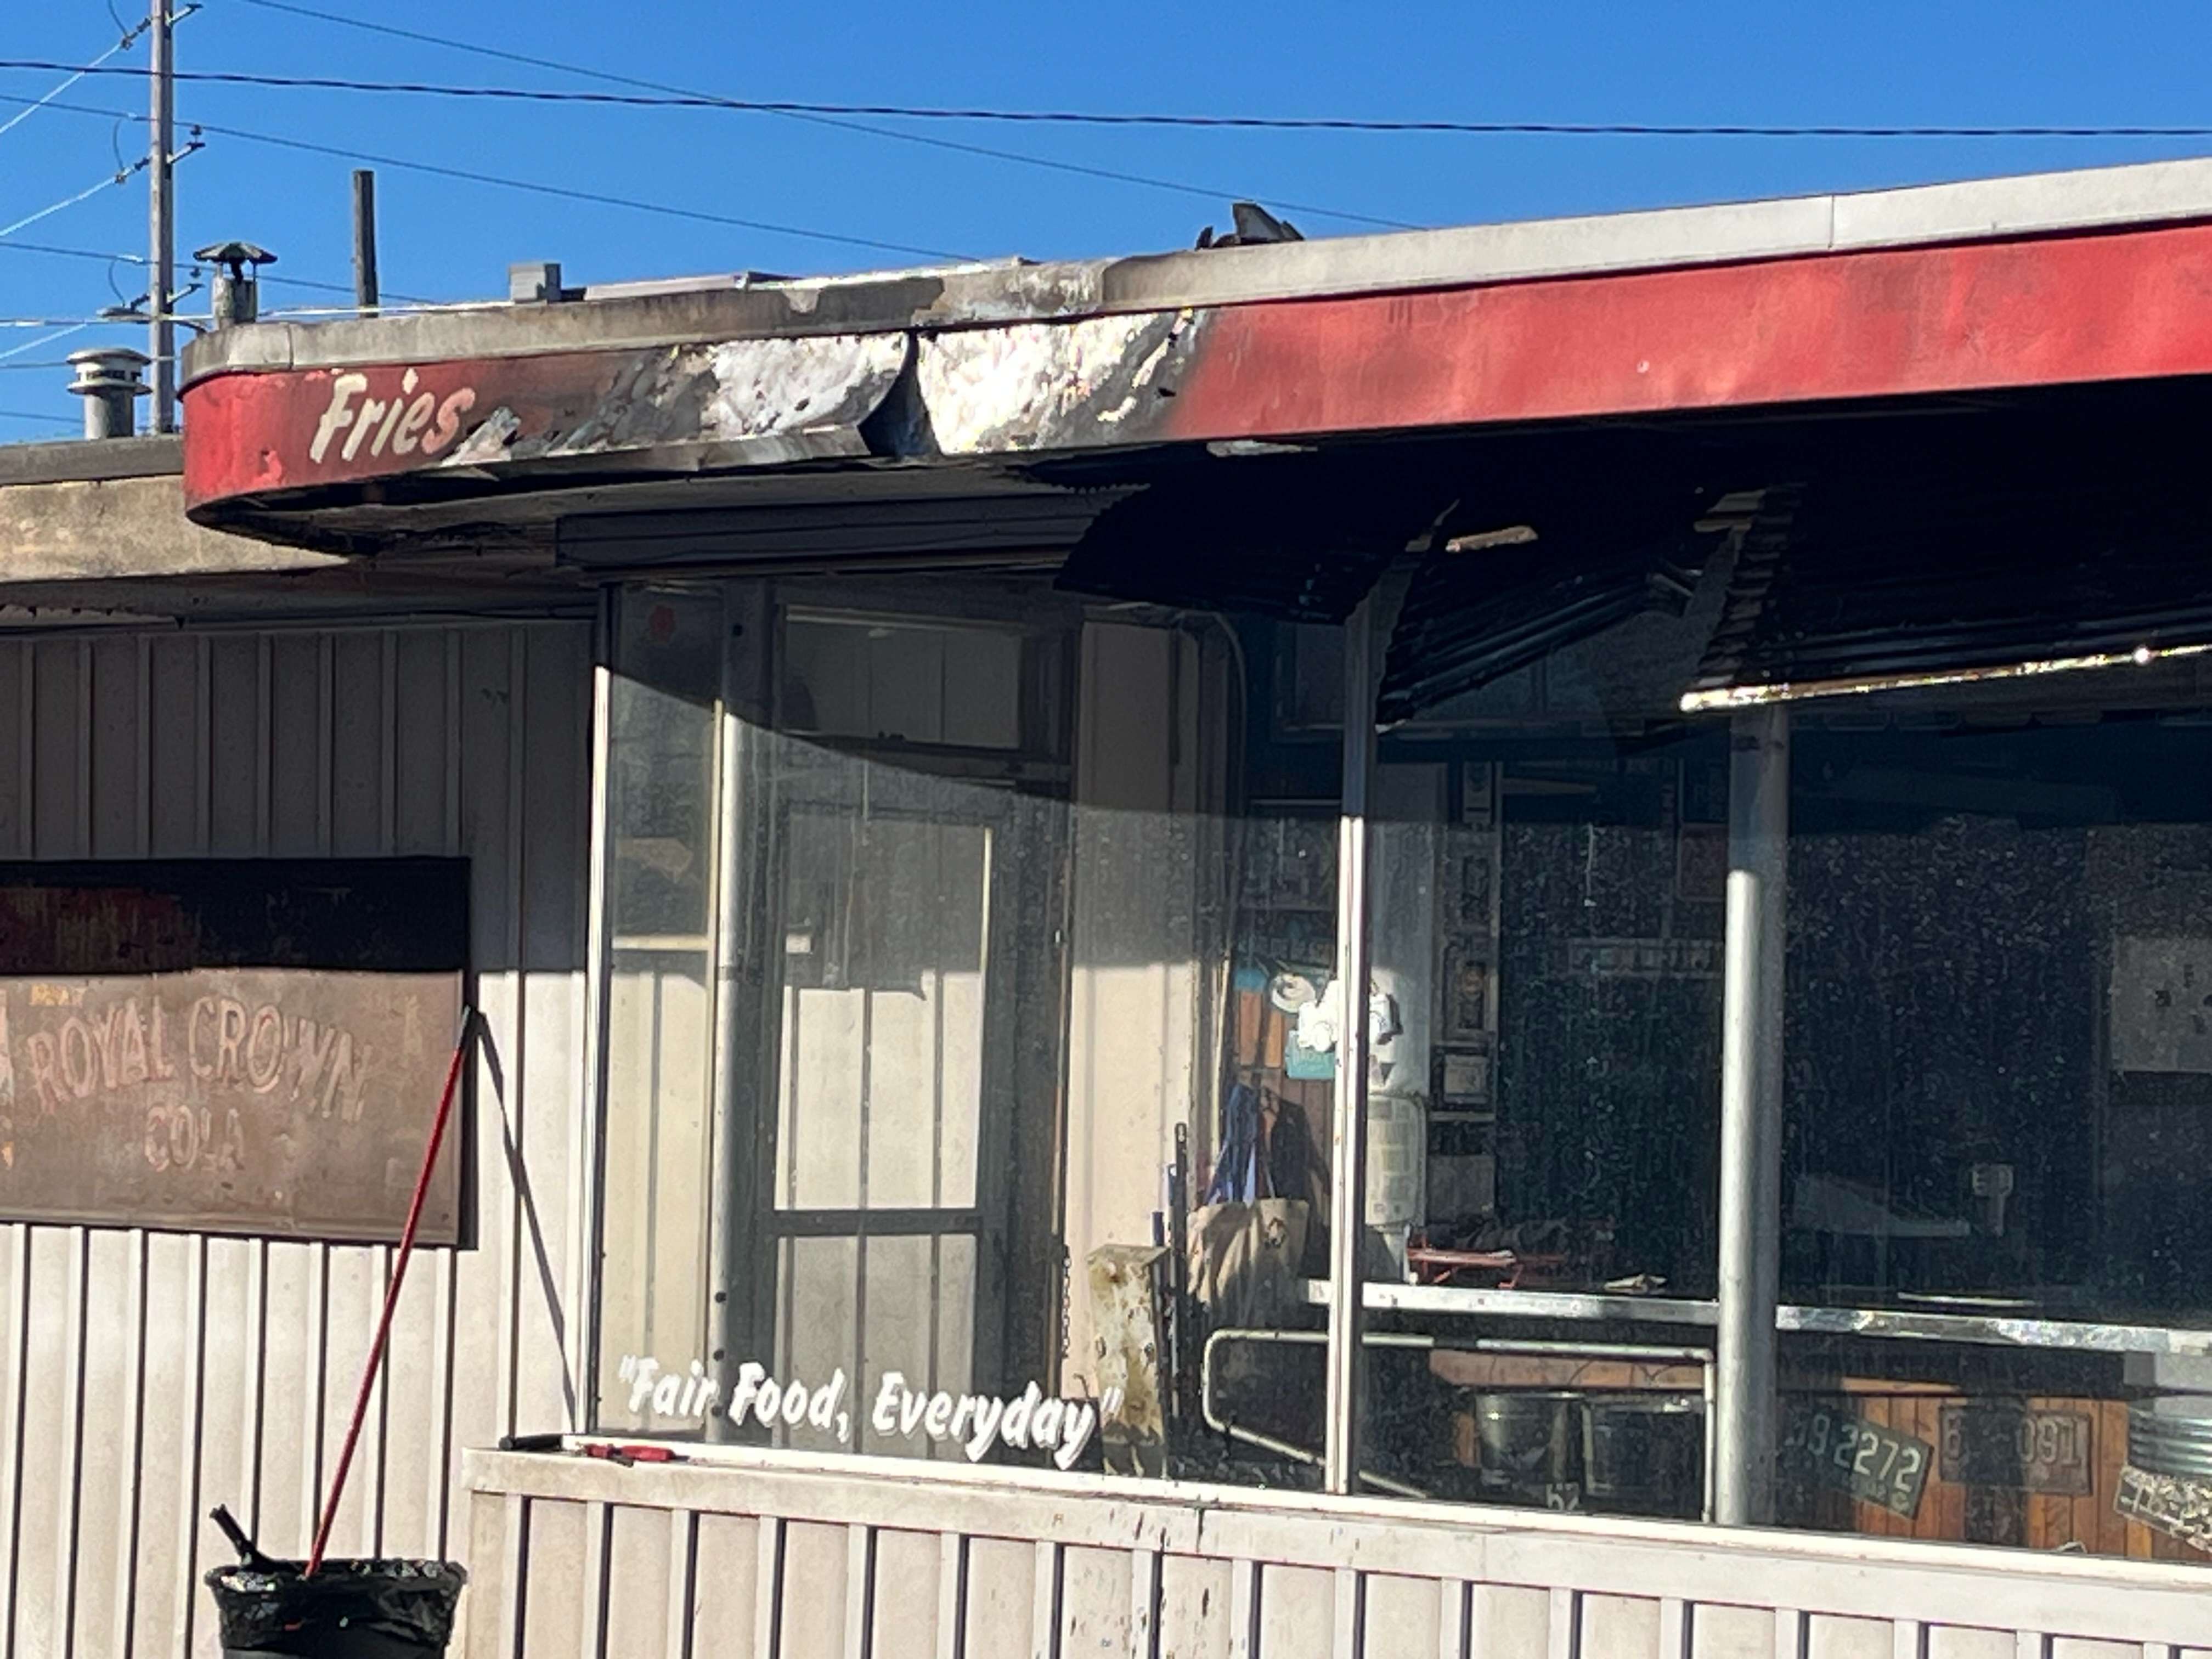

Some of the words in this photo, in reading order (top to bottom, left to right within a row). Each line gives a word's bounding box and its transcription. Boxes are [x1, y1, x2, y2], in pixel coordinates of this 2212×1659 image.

[309, 368, 475, 464] Fries
[27, 996, 174, 1114] ROYAL
[188, 995, 373, 1123] CROWN
[618, 1355, 718, 1417] "Fair
[729, 1361, 850, 1443] Food,
[872, 1371, 1124, 1471] Everyday"
